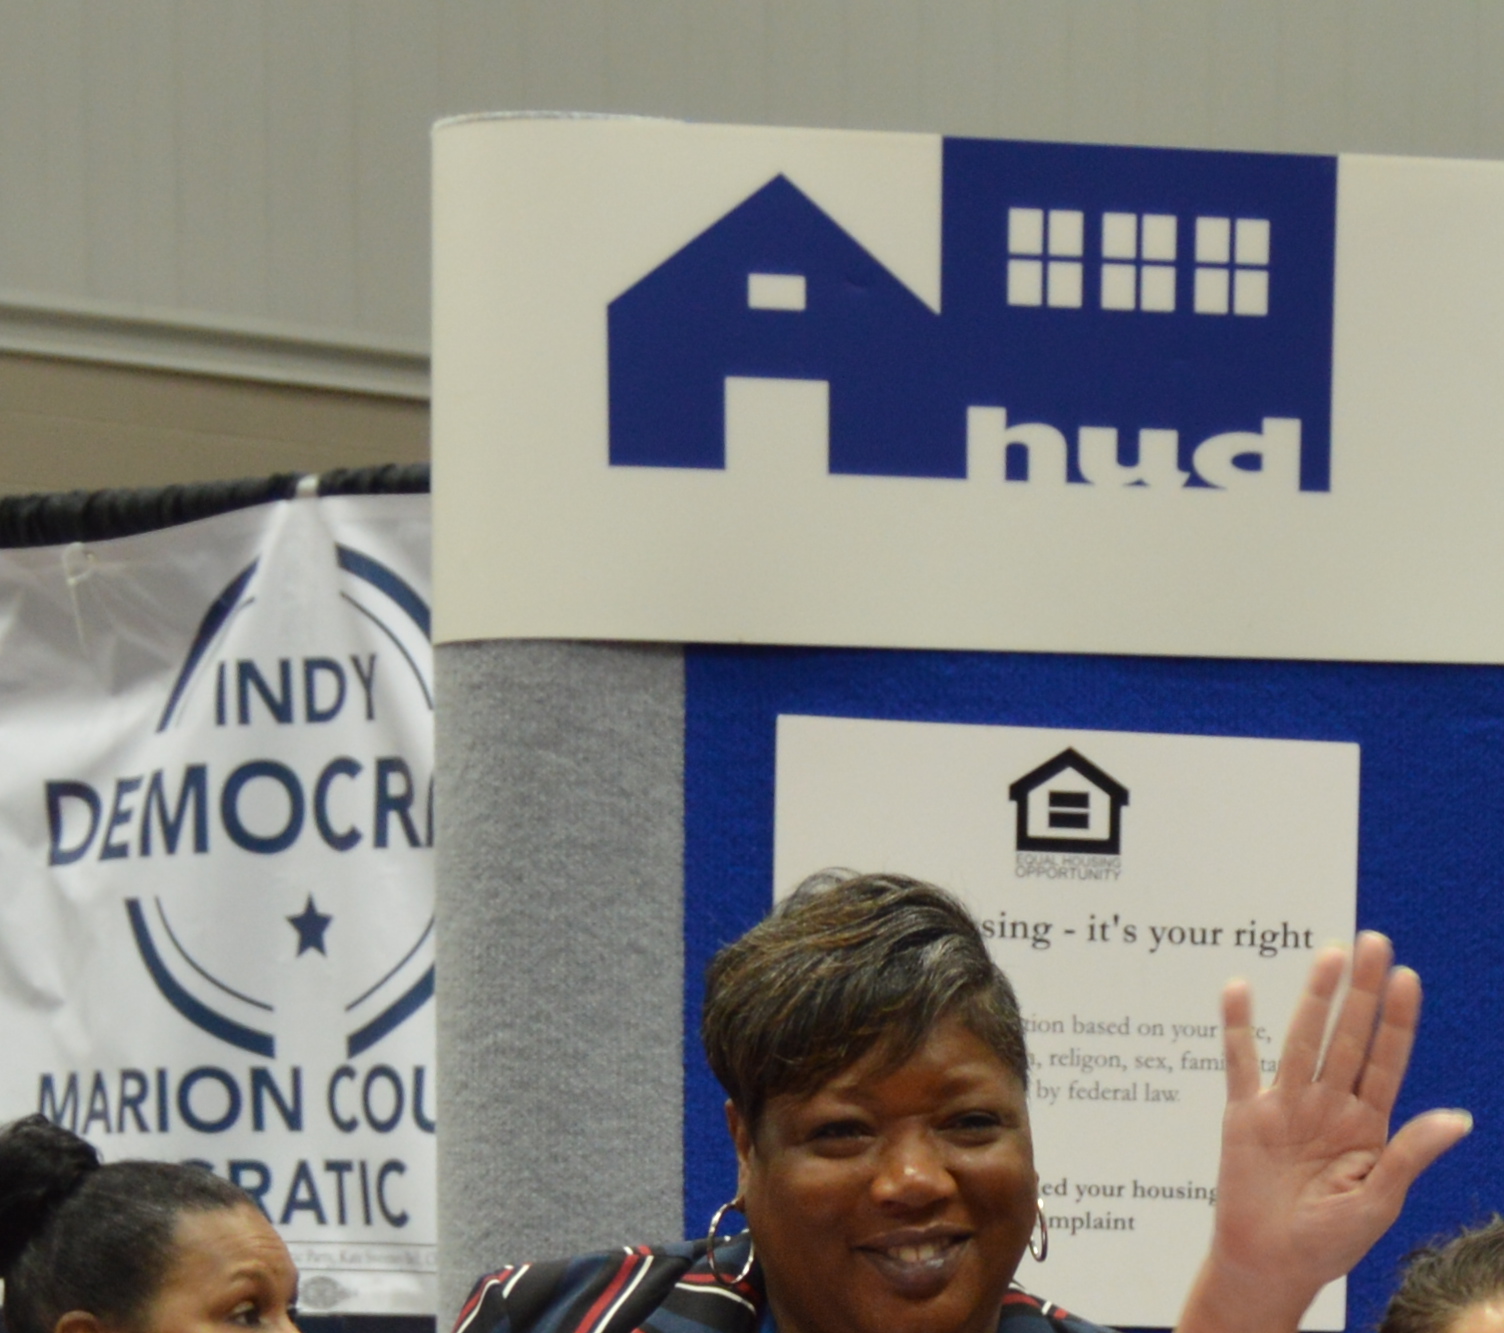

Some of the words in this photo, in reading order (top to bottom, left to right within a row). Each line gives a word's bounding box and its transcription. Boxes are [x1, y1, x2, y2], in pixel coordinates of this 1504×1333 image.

[966, 405, 1301, 490] hud
[215, 653, 378, 727] INDY
[44, 756, 435, 867] DEMOCR
[1016, 865, 1121, 880] OPPORTUNITY
[982, 911, 1053, 950] sing
[1088, 913, 1137, 943] it's
[1149, 926, 1224, 954] your
[1234, 919, 1312, 957] right
[1072, 1014, 1131, 1036] based
[1136, 1023, 1165, 1037] on
[1171, 1024, 1219, 1043] your
[1134, 1055, 1174, 1074] sex,
[1180, 1047, 1225, 1072] fami
[39, 1065, 303, 1135] MARION
[327, 1063, 437, 1134] COU
[1036, 1079, 1060, 1105] by
[1068, 1079, 1138, 1102] federal
[180, 1158, 410, 1229] RATIC
[1075, 1184, 1125, 1203] your
[1132, 1179, 1217, 1207] housing
[1046, 1211, 1135, 1236] mplaint
